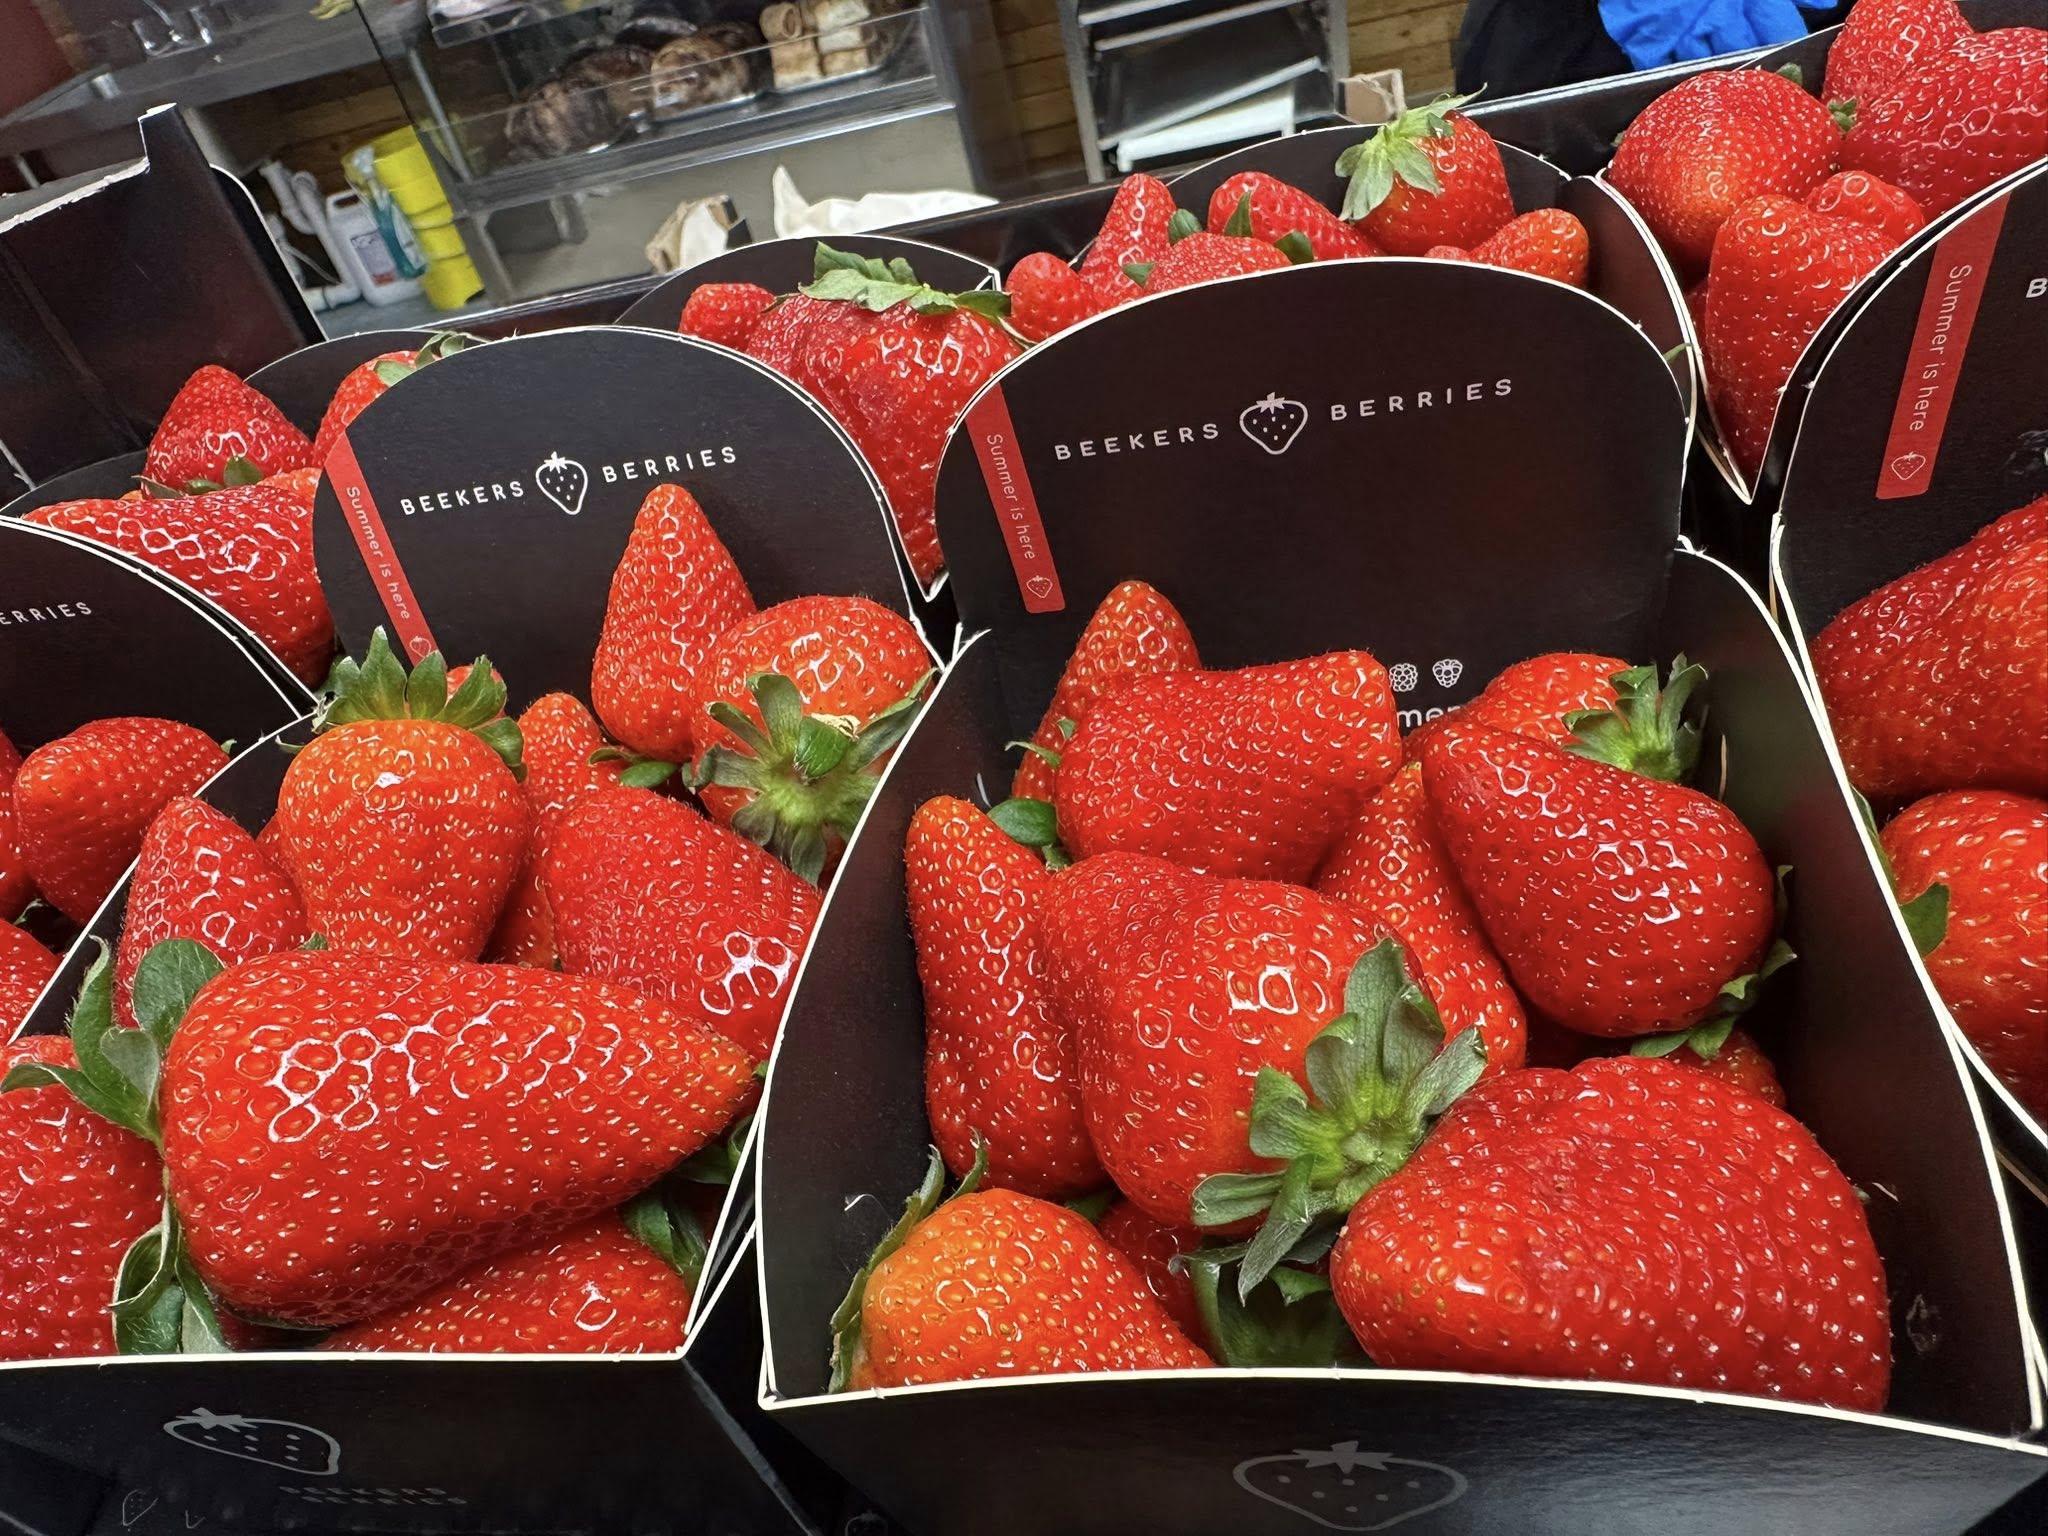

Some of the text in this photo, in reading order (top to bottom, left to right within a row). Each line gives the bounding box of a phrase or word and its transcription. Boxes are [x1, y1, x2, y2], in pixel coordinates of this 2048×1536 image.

[1908, 263, 1974, 432] Summer is here
[400, 446, 736, 516] BEEKERS BERRIES
[1054, 378, 1512, 461] BEEKERS BERRIES
[346, 486, 411, 619] Summer is here
[986, 433, 1036, 560] Summer is here
